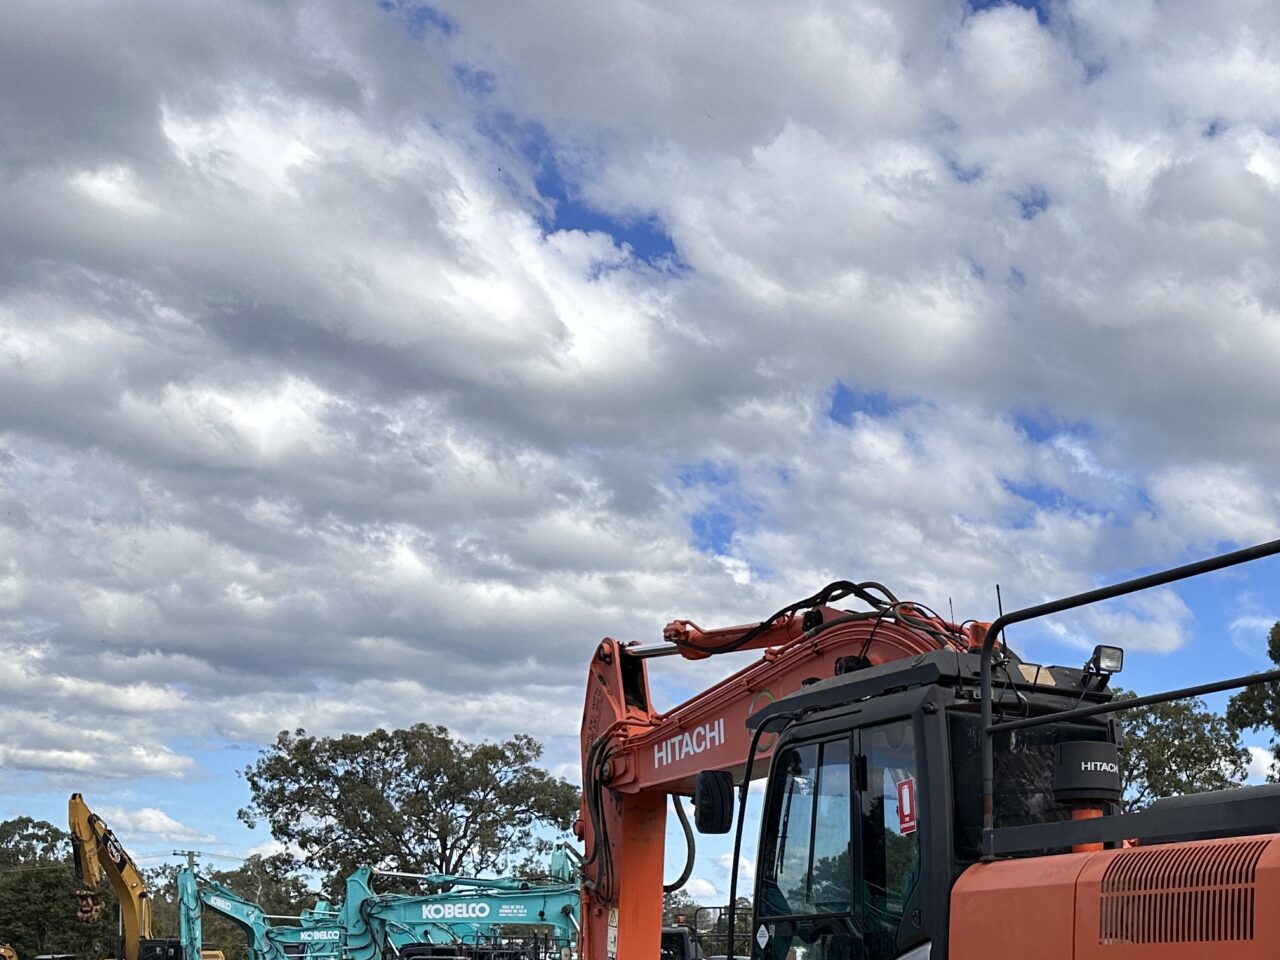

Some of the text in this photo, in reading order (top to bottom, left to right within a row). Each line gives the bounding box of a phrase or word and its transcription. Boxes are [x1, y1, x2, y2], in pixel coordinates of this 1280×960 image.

[654, 718, 725, 769] HITACHI
[1081, 761, 1119, 774] HITACH
[422, 903, 490, 919] KOBELCO
[300, 930, 340, 941] KOBELCO
